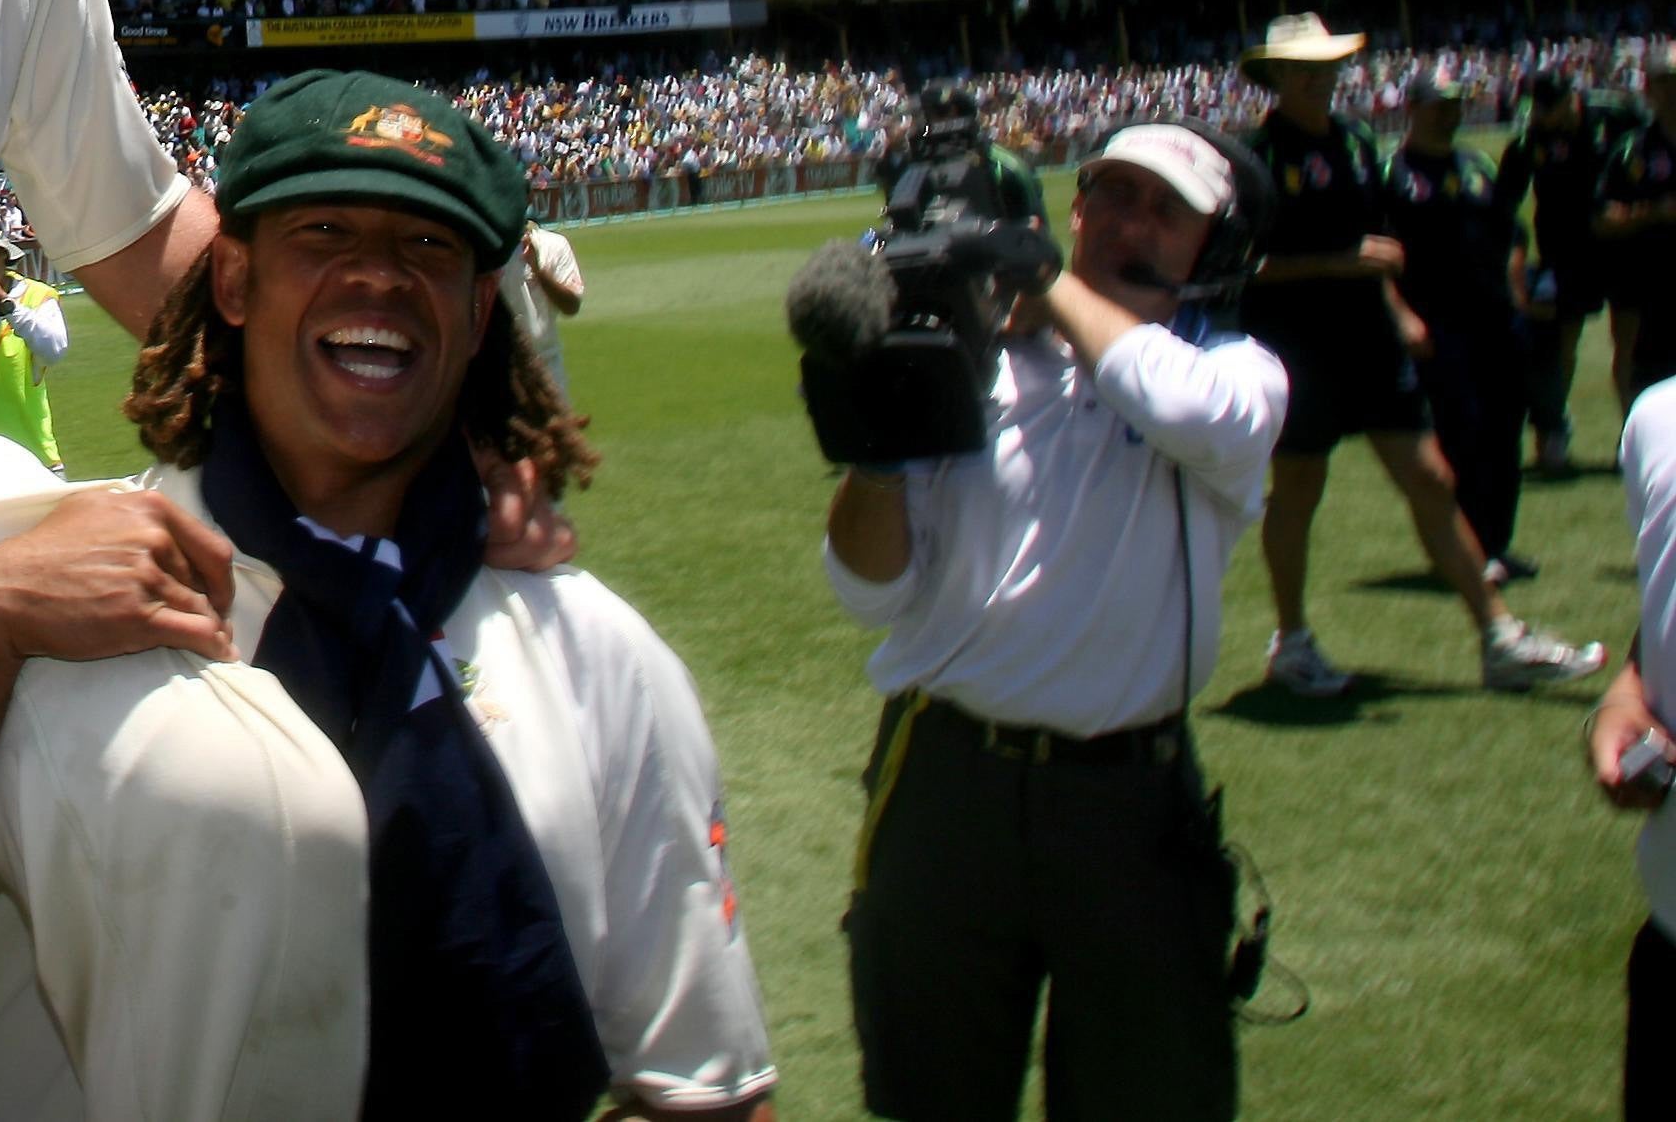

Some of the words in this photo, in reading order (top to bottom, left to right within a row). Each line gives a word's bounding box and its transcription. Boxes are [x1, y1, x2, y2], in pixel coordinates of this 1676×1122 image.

[544, 14, 580, 32] NSW
[120, 25, 144, 37] Good
[145, 25, 169, 36] times
